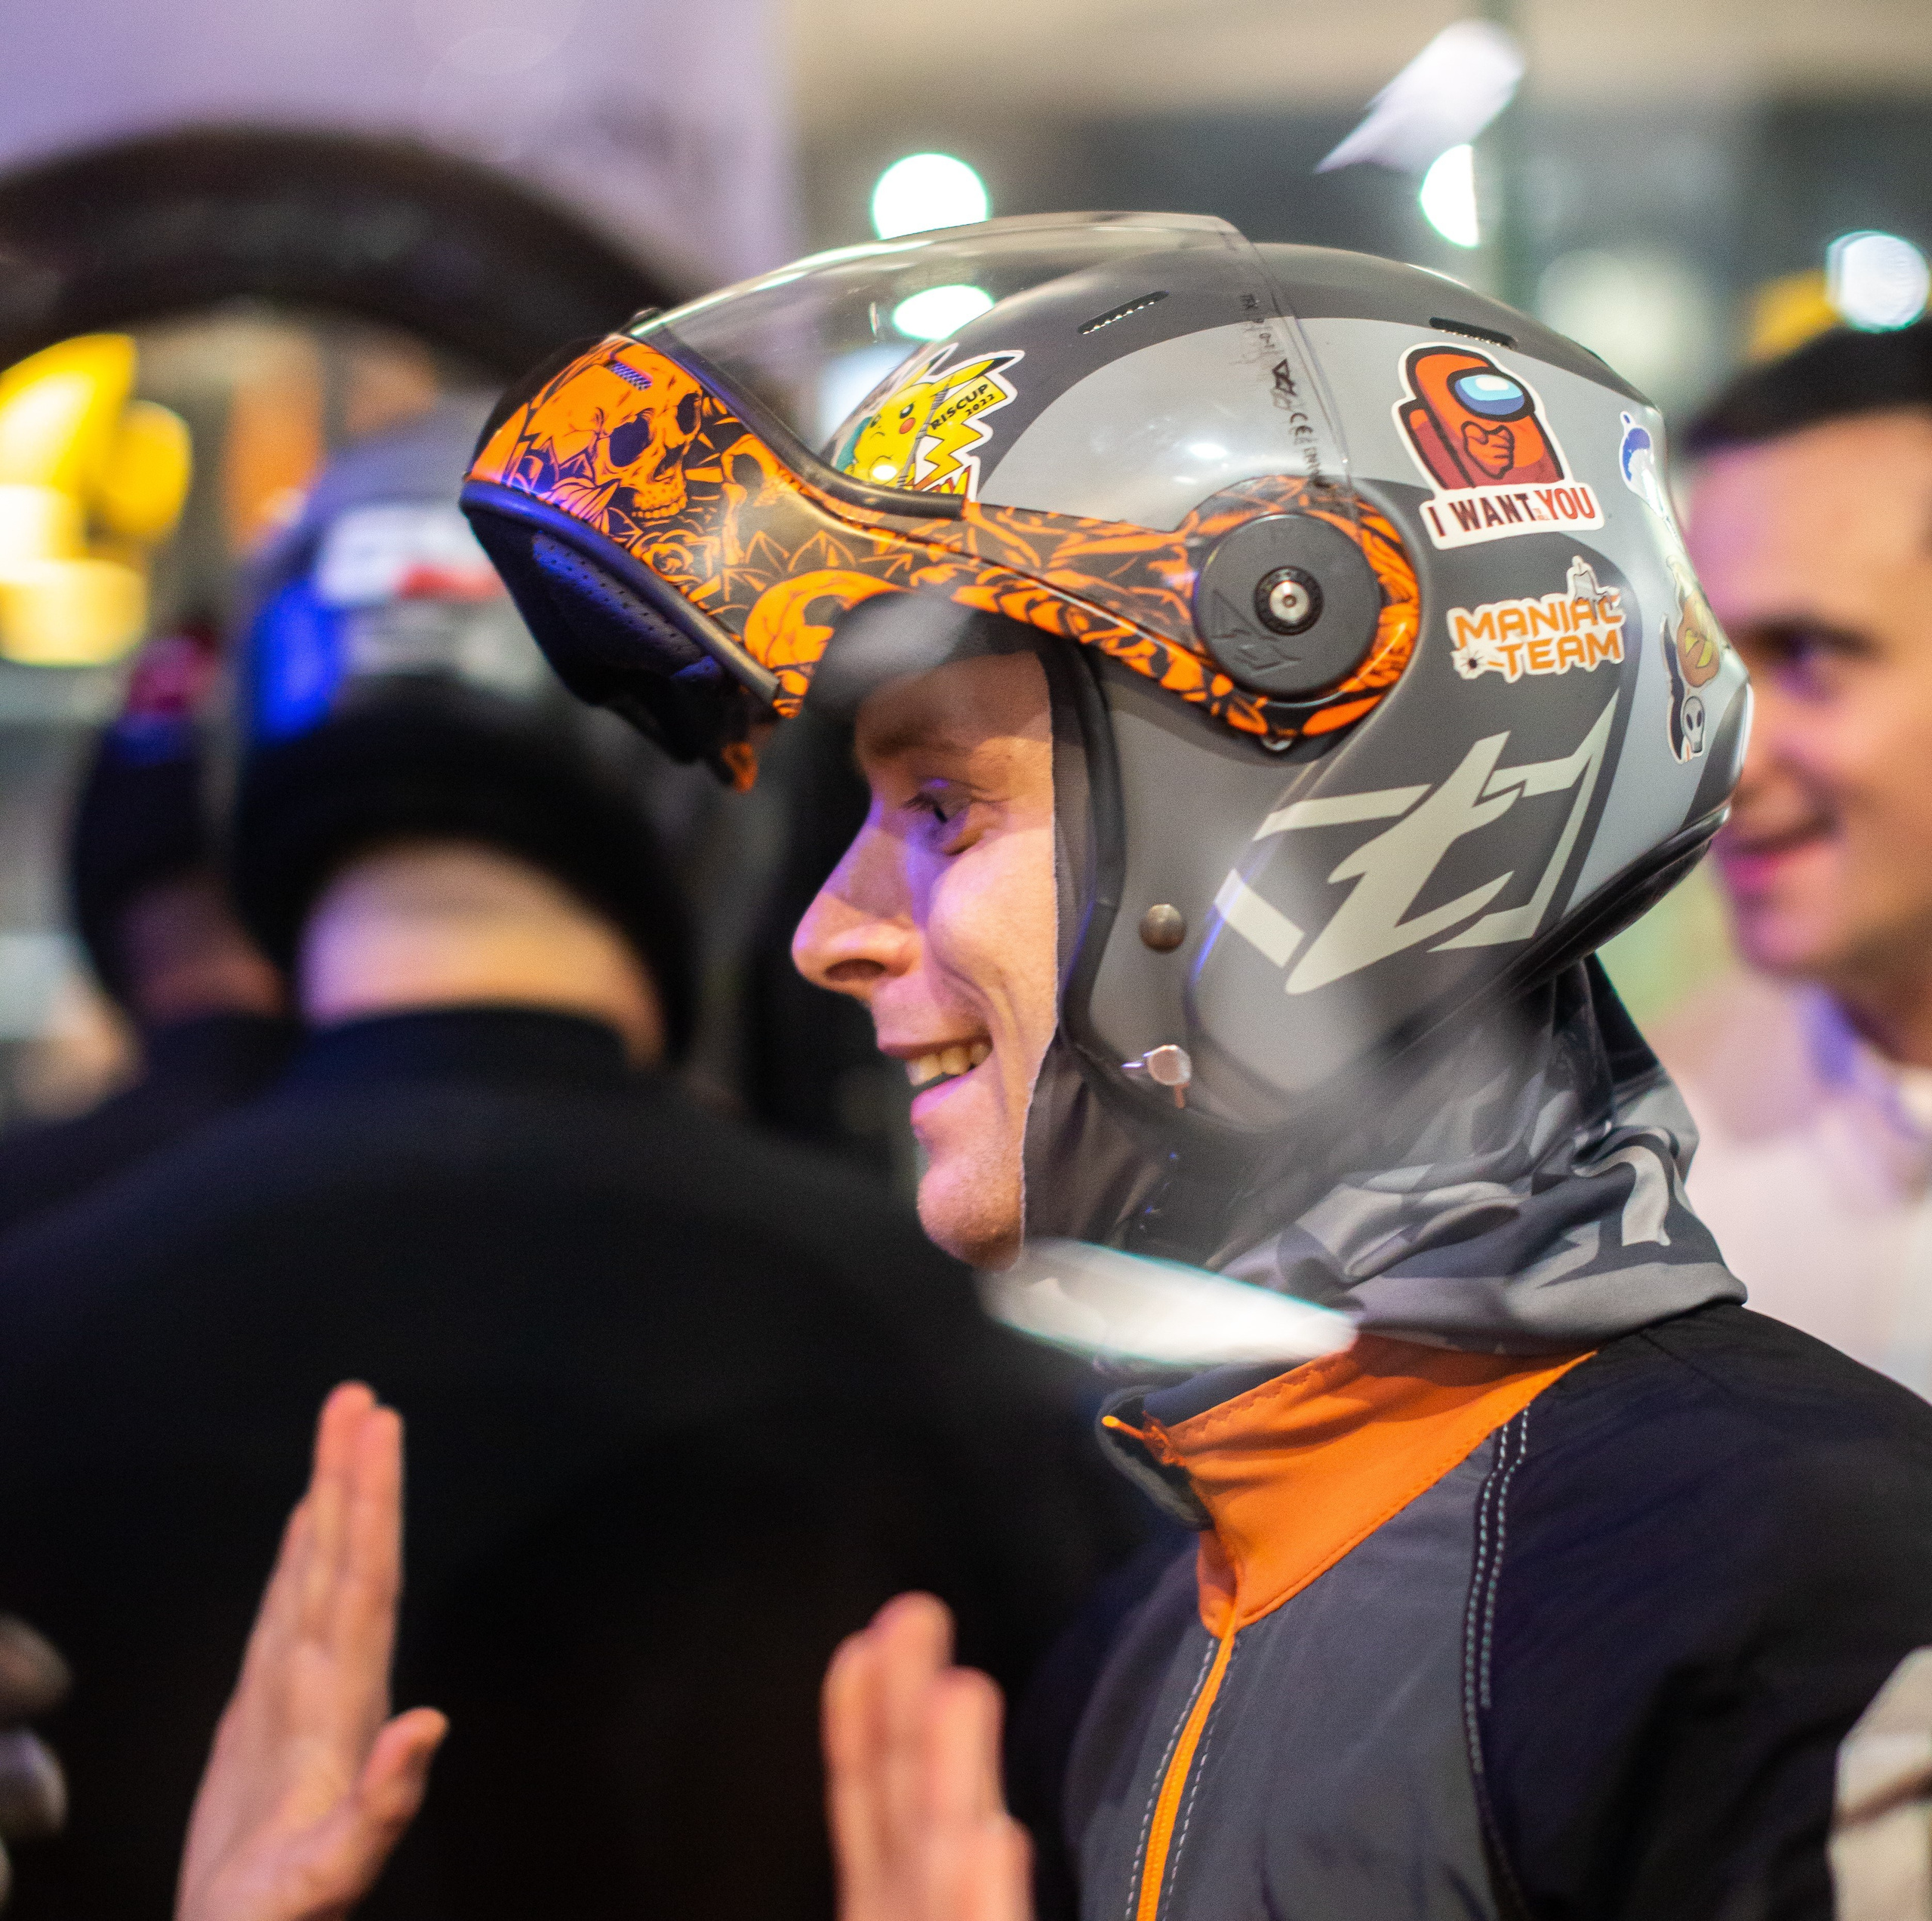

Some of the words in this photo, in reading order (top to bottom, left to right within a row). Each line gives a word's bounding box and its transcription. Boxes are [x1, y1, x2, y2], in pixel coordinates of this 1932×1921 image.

[930, 383, 989, 430] RISCUP
[965, 393, 995, 416] 2022
[1428, 506, 1446, 537] I
[1448, 492, 1537, 532] WANT
[1534, 487, 1596, 521] YOU
[1454, 594, 1624, 651] MANIAC
[1495, 629, 1622, 678] TEAM
